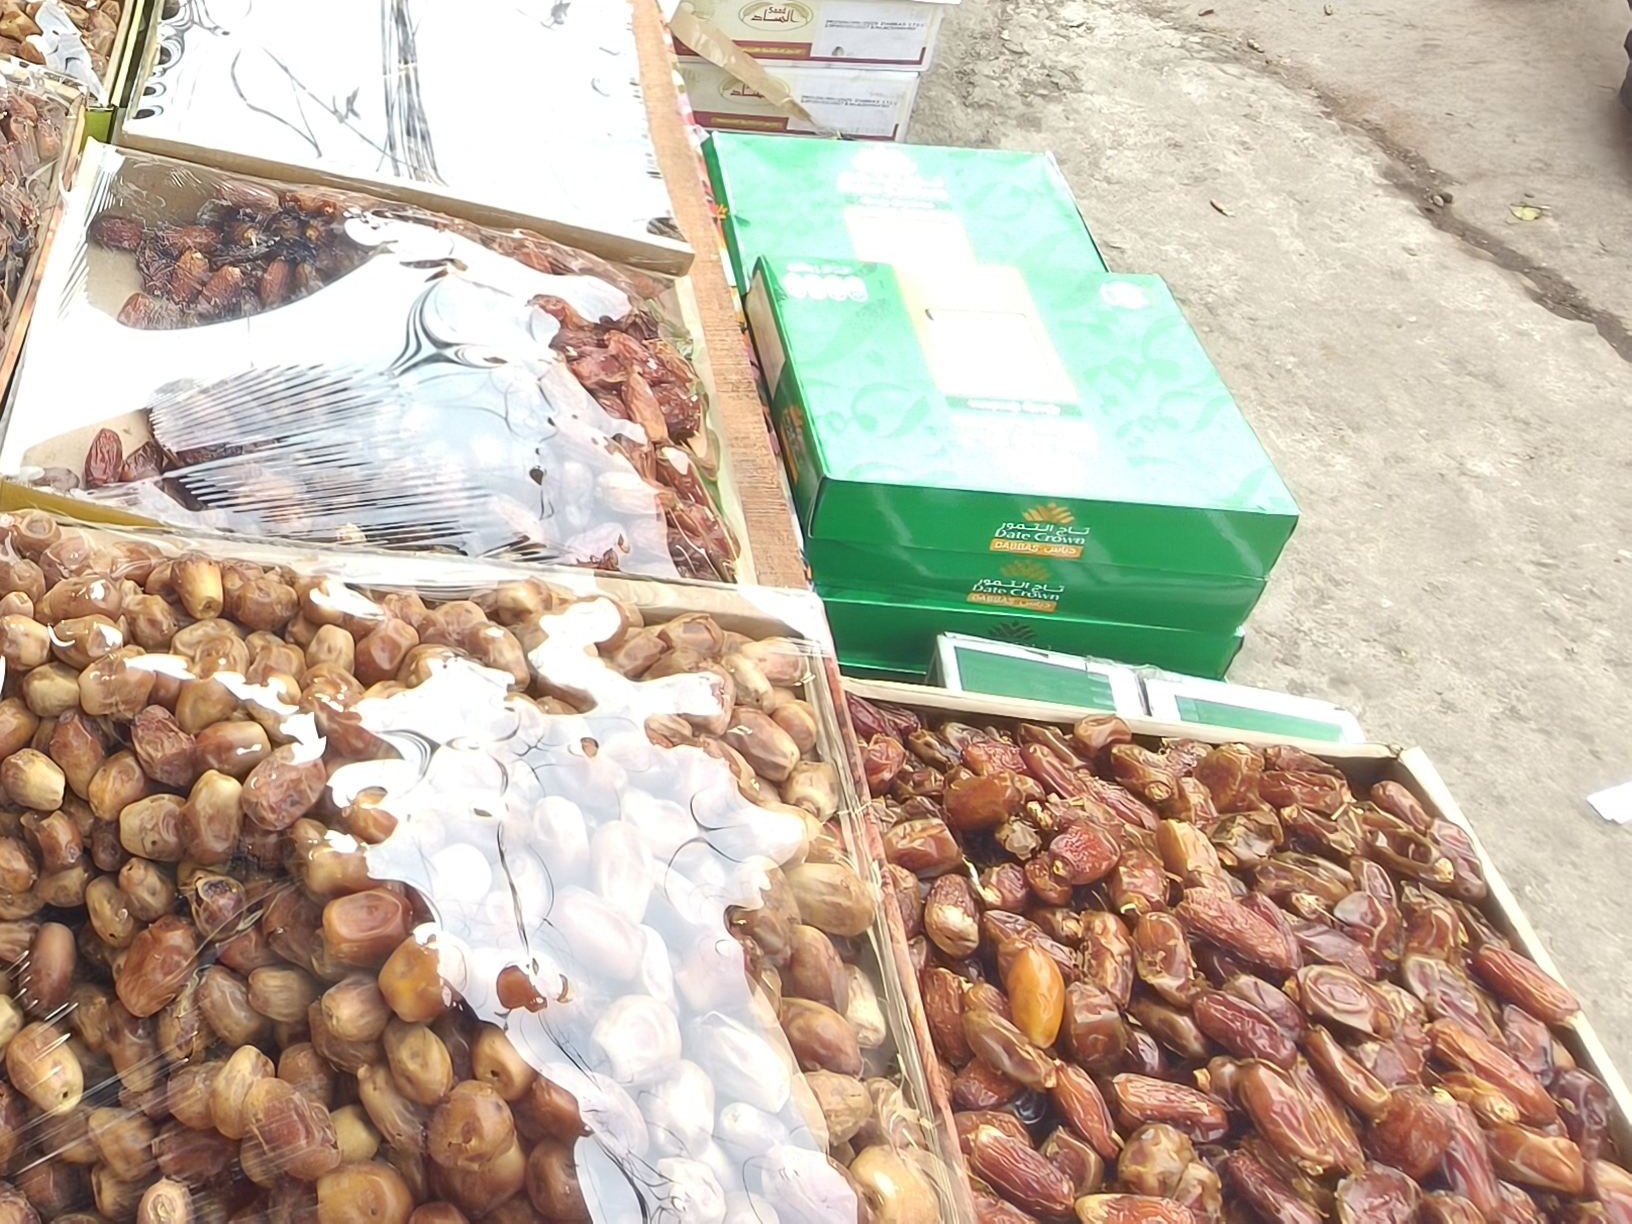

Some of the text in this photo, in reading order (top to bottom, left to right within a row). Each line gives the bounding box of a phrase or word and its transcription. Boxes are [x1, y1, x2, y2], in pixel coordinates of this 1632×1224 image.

[995, 529, 1085, 545] Date Crown
[972, 584, 1059, 601] Date Crown
